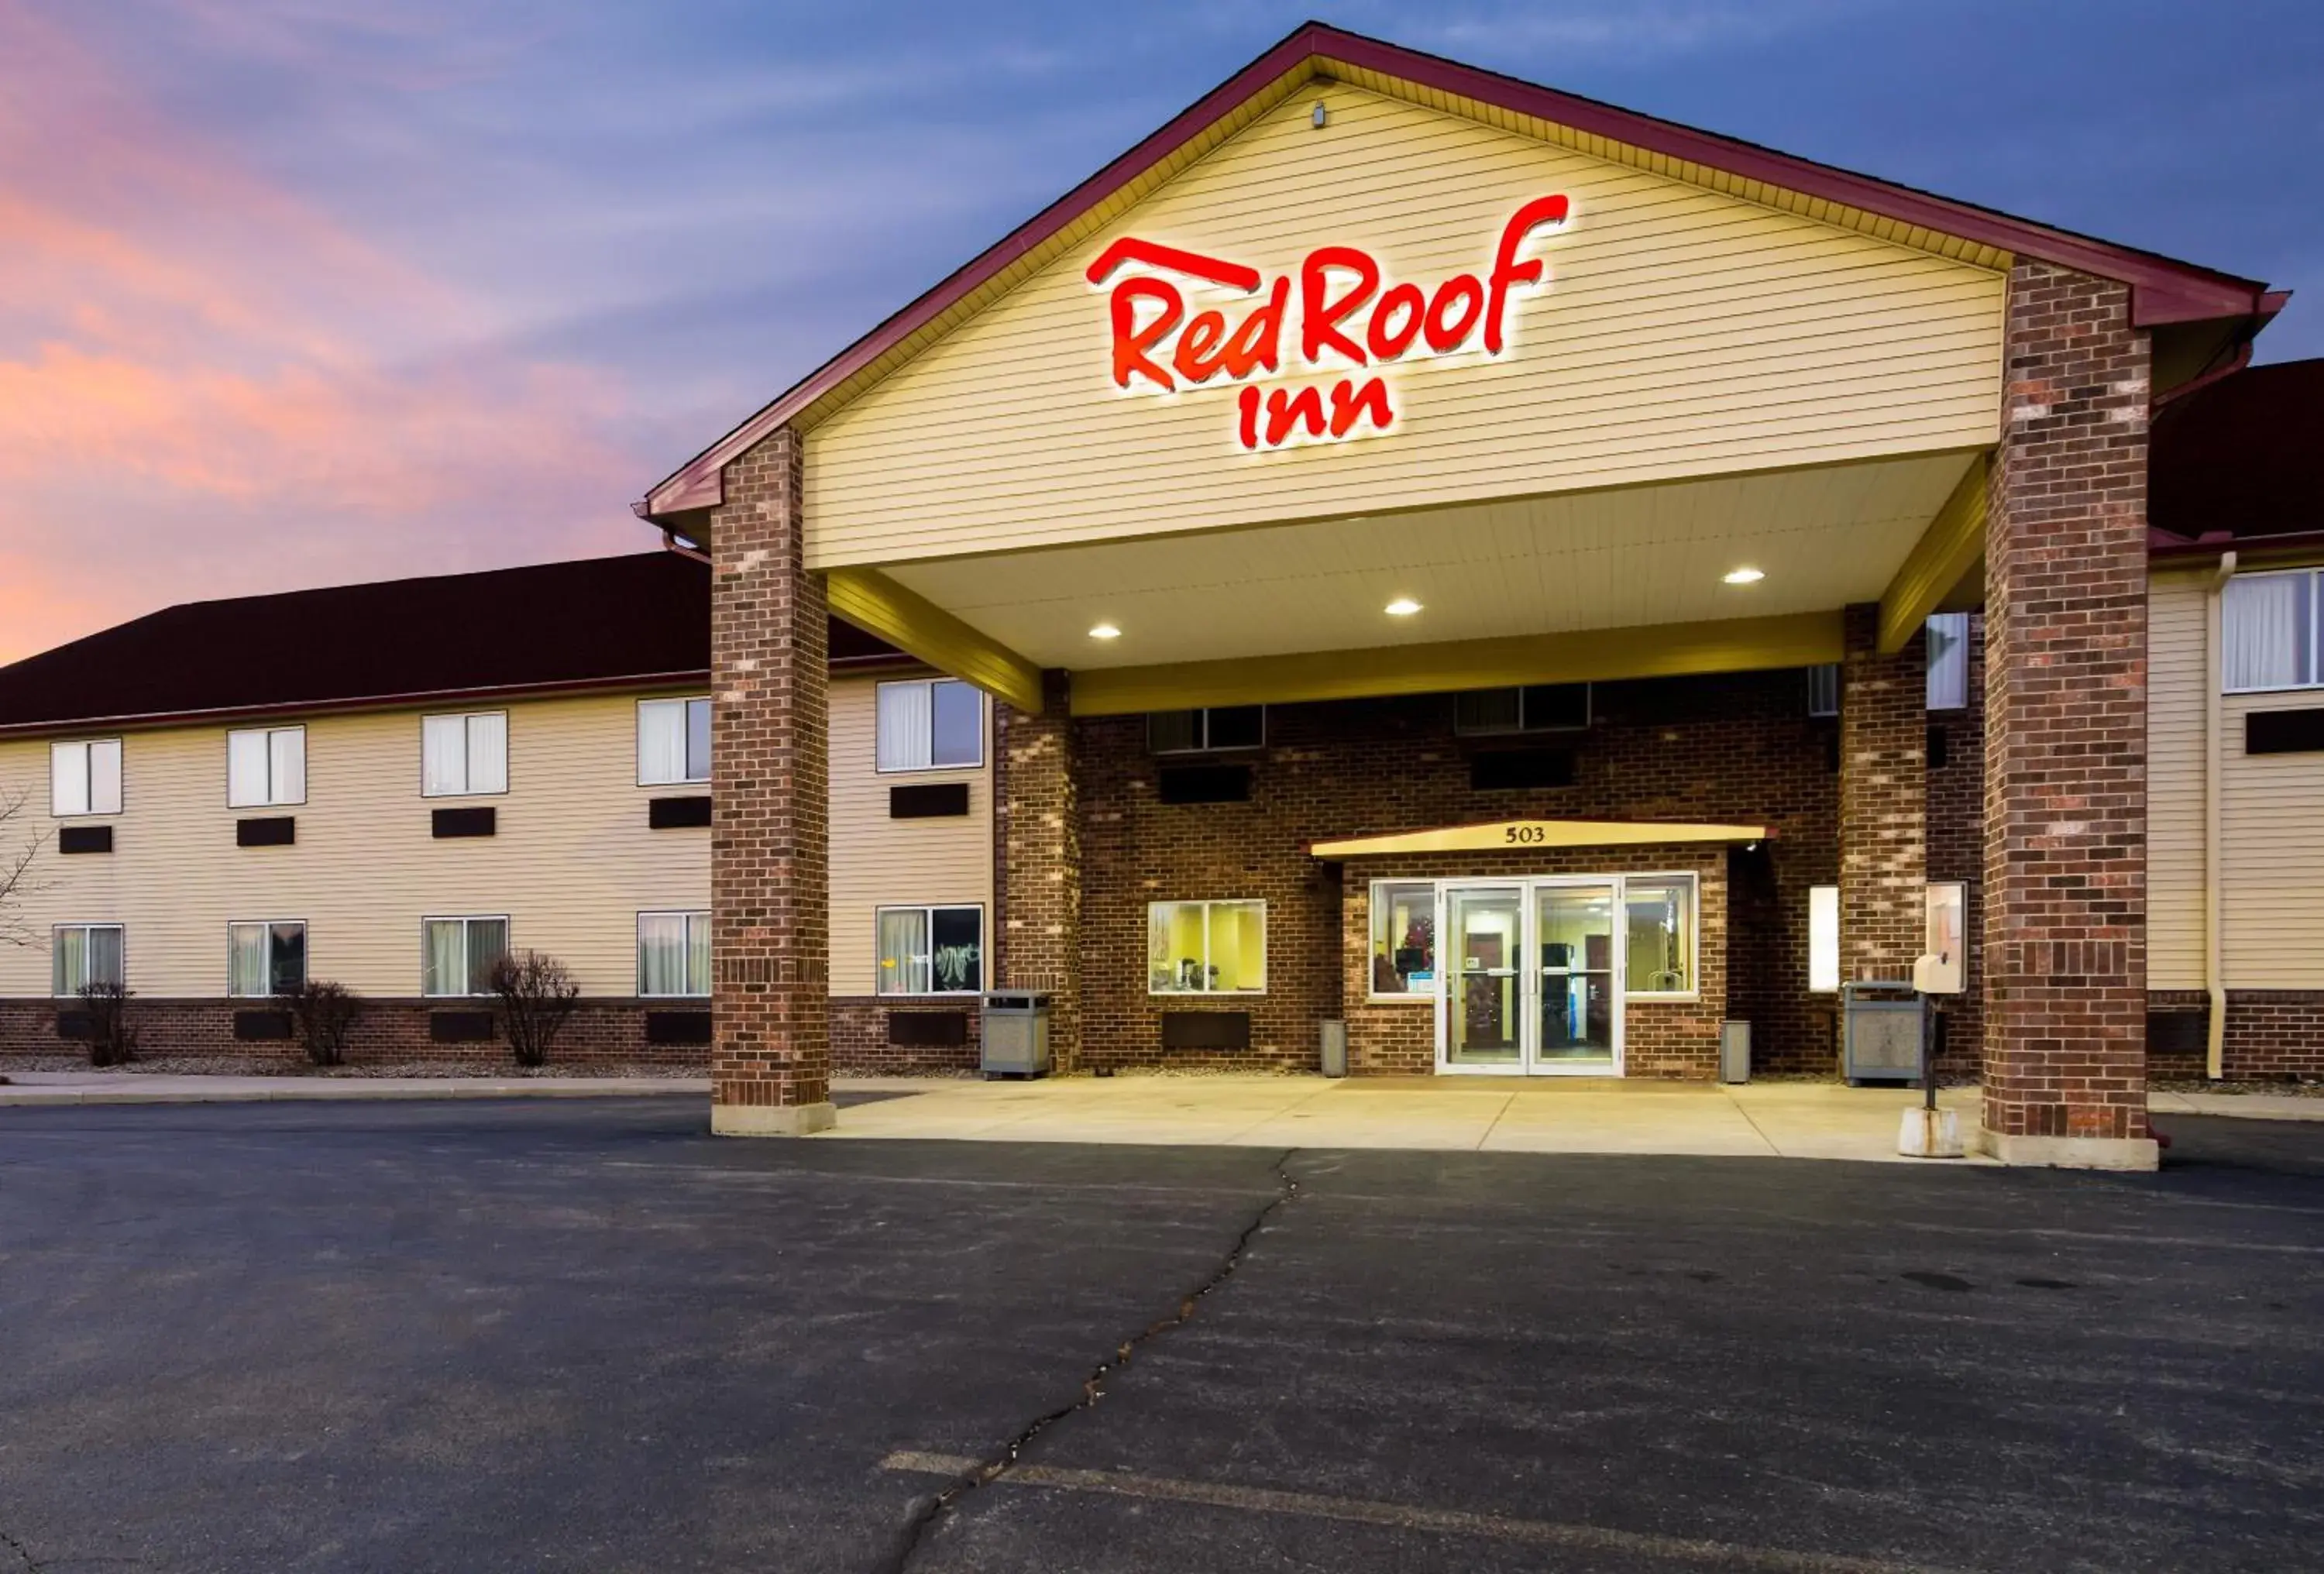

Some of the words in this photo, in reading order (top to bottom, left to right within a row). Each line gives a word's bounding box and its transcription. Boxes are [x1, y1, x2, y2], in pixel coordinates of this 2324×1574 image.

[1111, 276, 1291, 391] Red
[1302, 194, 1569, 366] Roof
[1505, 827, 1545, 844] 503
